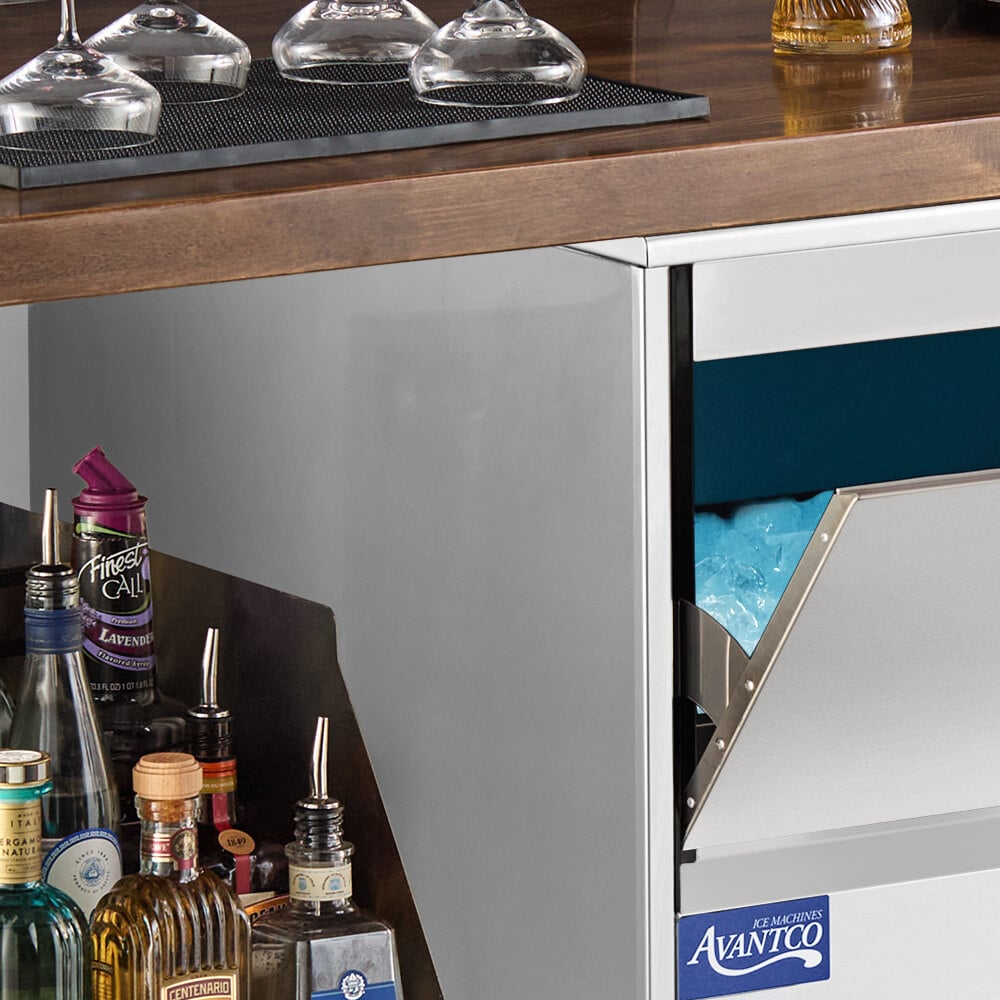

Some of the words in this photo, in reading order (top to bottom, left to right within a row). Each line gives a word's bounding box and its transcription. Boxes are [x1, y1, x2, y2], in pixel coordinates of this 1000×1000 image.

[78, 542, 149, 584] Finest
[102, 572, 144, 600] CALL
[226, 837, 247, 848] 1849
[753, 917, 769, 930] ICE
[771, 909, 823, 927] MACHINES
[686, 922, 824, 976] AVANTCO
